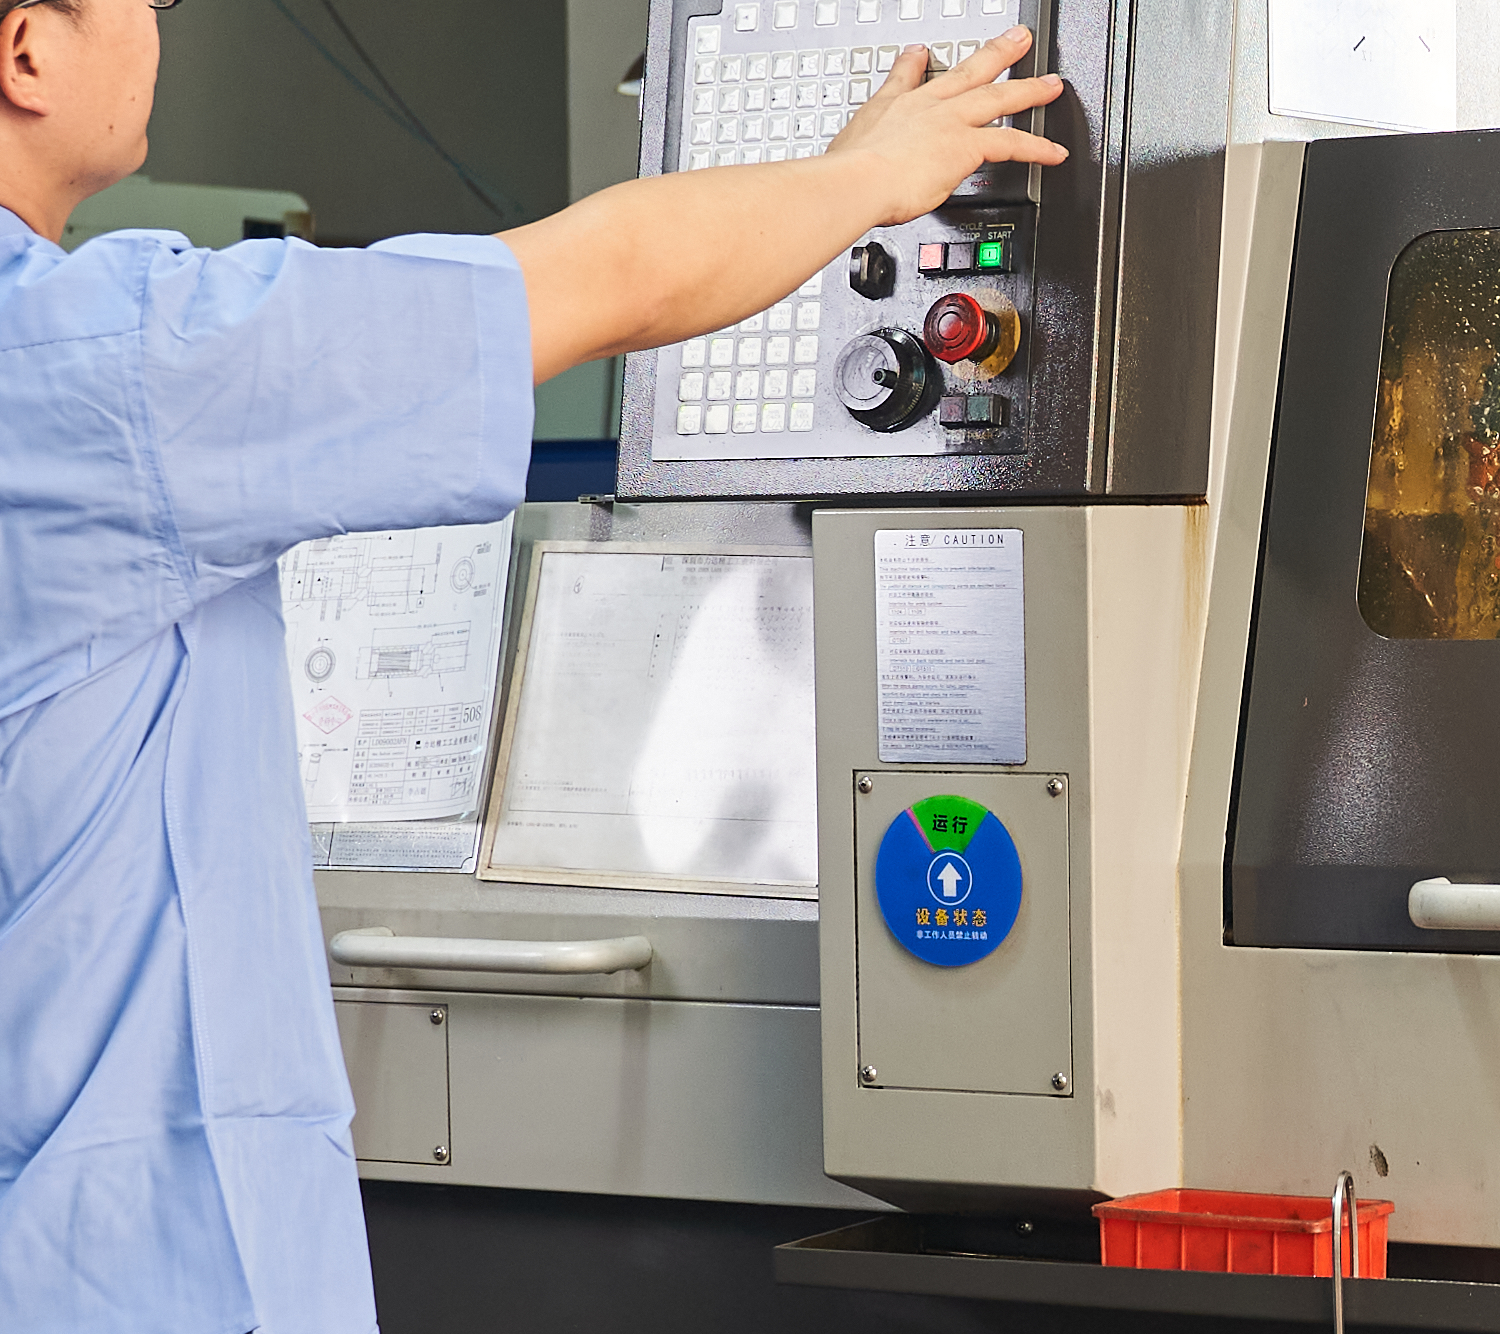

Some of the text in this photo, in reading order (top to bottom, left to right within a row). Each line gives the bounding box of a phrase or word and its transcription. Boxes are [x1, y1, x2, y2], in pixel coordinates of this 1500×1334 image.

[961, 231, 1012, 241] STOP START
[944, 534, 1004, 545] CAUTION
[932, 814, 968, 834] 运行
[916, 908, 987, 927] 设备状态
